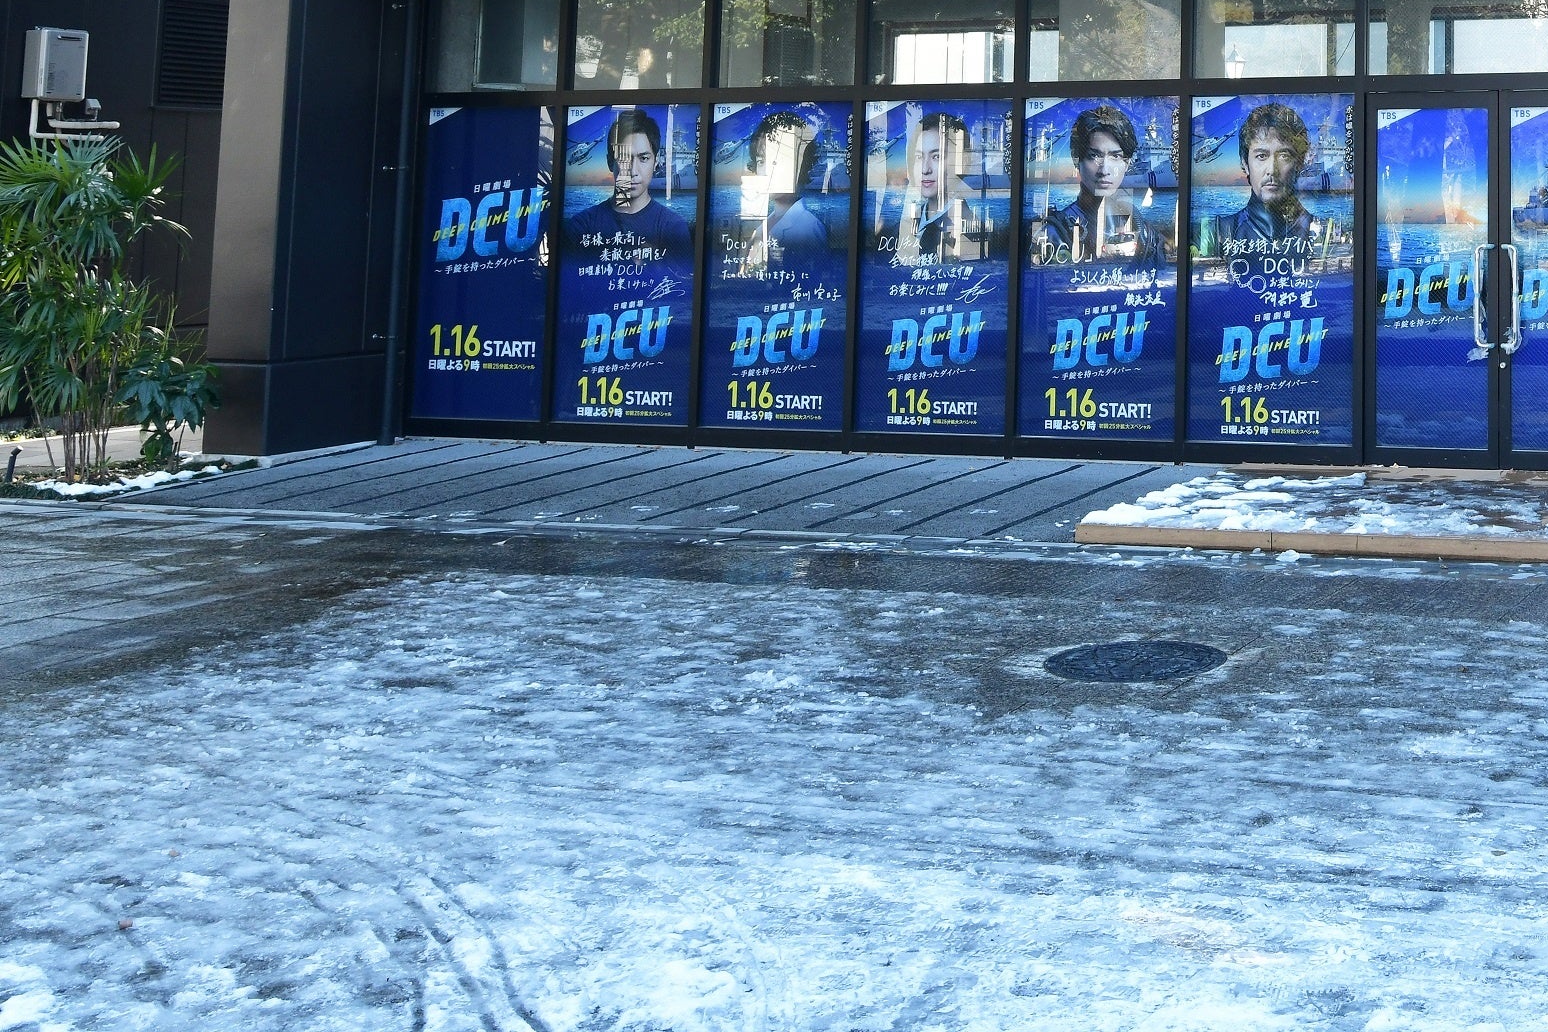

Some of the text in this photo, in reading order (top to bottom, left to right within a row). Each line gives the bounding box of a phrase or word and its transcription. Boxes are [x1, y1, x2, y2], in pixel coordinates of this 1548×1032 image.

[1196, 100, 1211, 108] TBS
[474, 180, 511, 193] 日曜劇場
[435, 188, 544, 262] DCU
[1384, 260, 1478, 319] DCU
[613, 300, 643, 310] 日曜劇場
[764, 302, 795, 312] 日曜劇場
[920, 305, 952, 315] 日曜劇場
[1084, 305, 1117, 315] 日曜劇場
[1254, 311, 1291, 322] 日曜劇場
[430, 324, 535, 357] 1.16 START!
[583, 306, 670, 364] DCU
[732, 308, 823, 367] DCU
[887, 311, 982, 372] DCU
[1052, 311, 1147, 371] DCU
[1219, 316, 1325, 383] DCU
[429, 359, 480, 371] 日曜よる9時
[577, 377, 672, 406] 1.16 START!
[728, 381, 822, 409] 1.16 START!
[888, 388, 977, 415] 1.16 START!
[577, 407, 623, 417] 日曜よる9時
[1045, 388, 1151, 419] 1.16 START!
[1221, 396, 1320, 424] 1.16 START!
[727, 410, 773, 421] 日曜よる9時
[887, 416, 930, 426] 日曜よる9時
[1044, 420, 1096, 431] 日曜よる9時
[1220, 426, 1268, 436] 日曜よる9時
